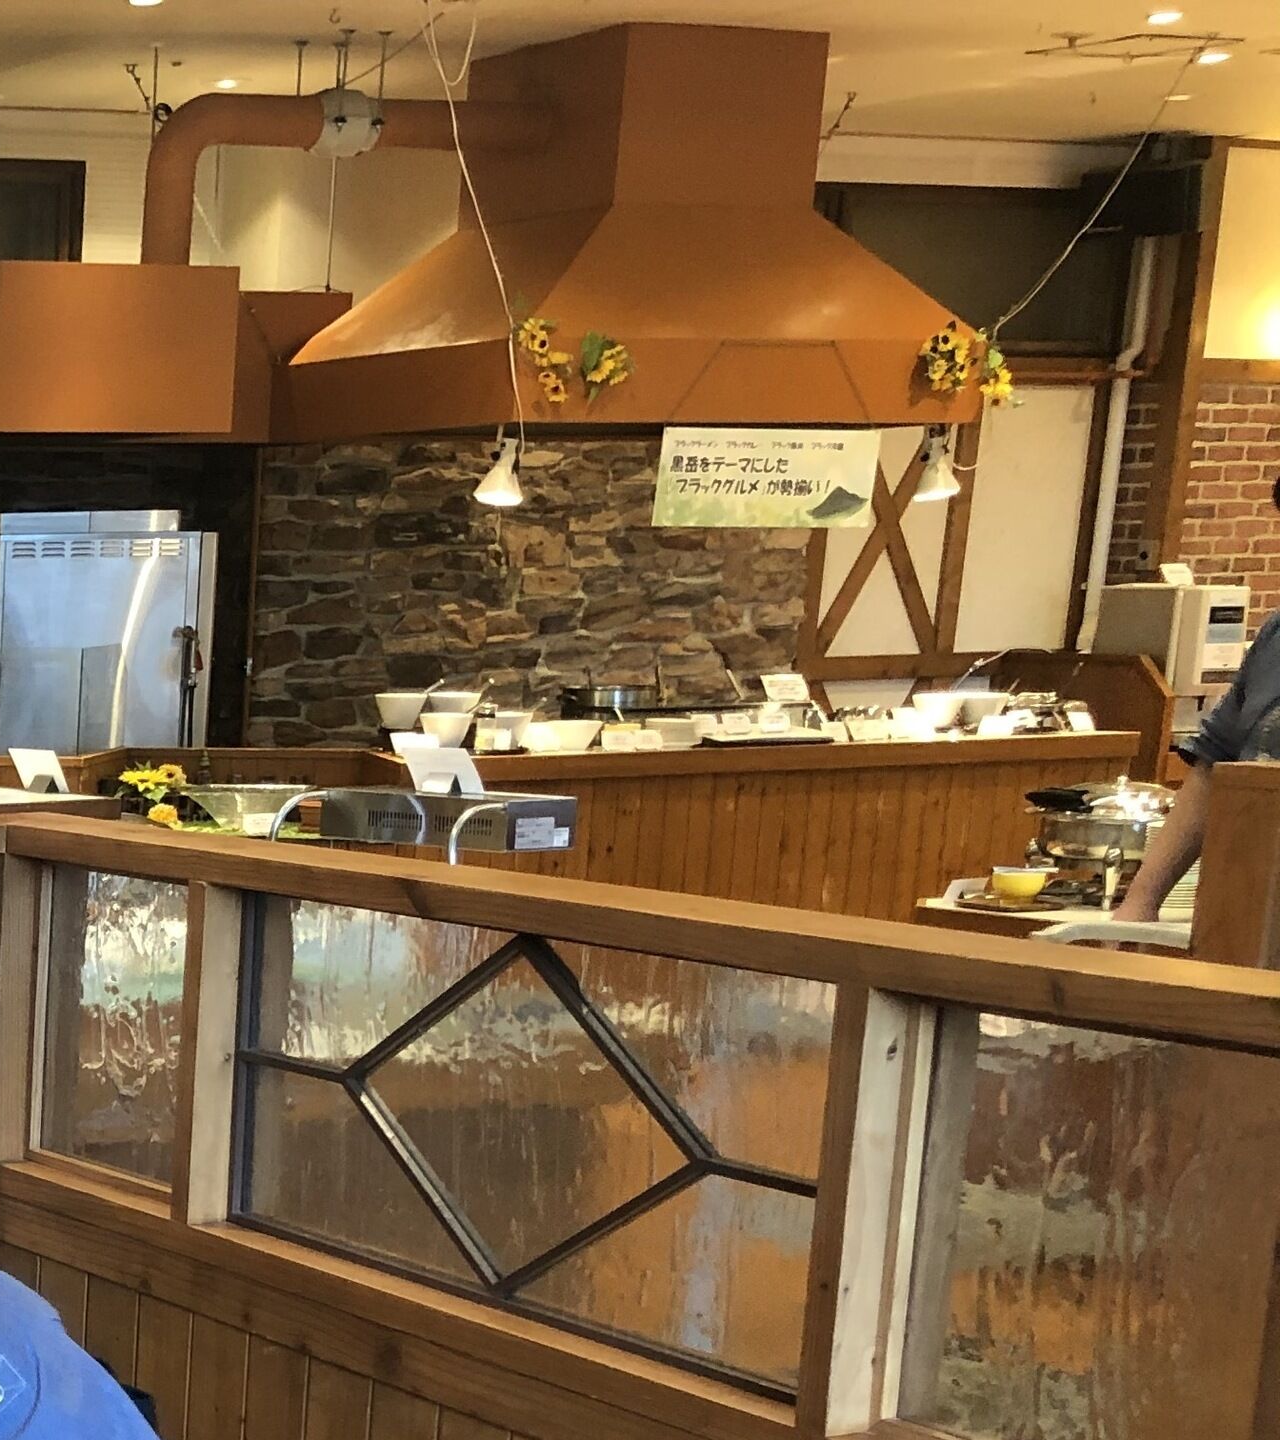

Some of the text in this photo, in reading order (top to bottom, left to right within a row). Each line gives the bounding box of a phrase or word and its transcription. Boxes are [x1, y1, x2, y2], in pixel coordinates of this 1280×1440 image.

[670, 455, 789, 474] 黒岳をテーマにした
